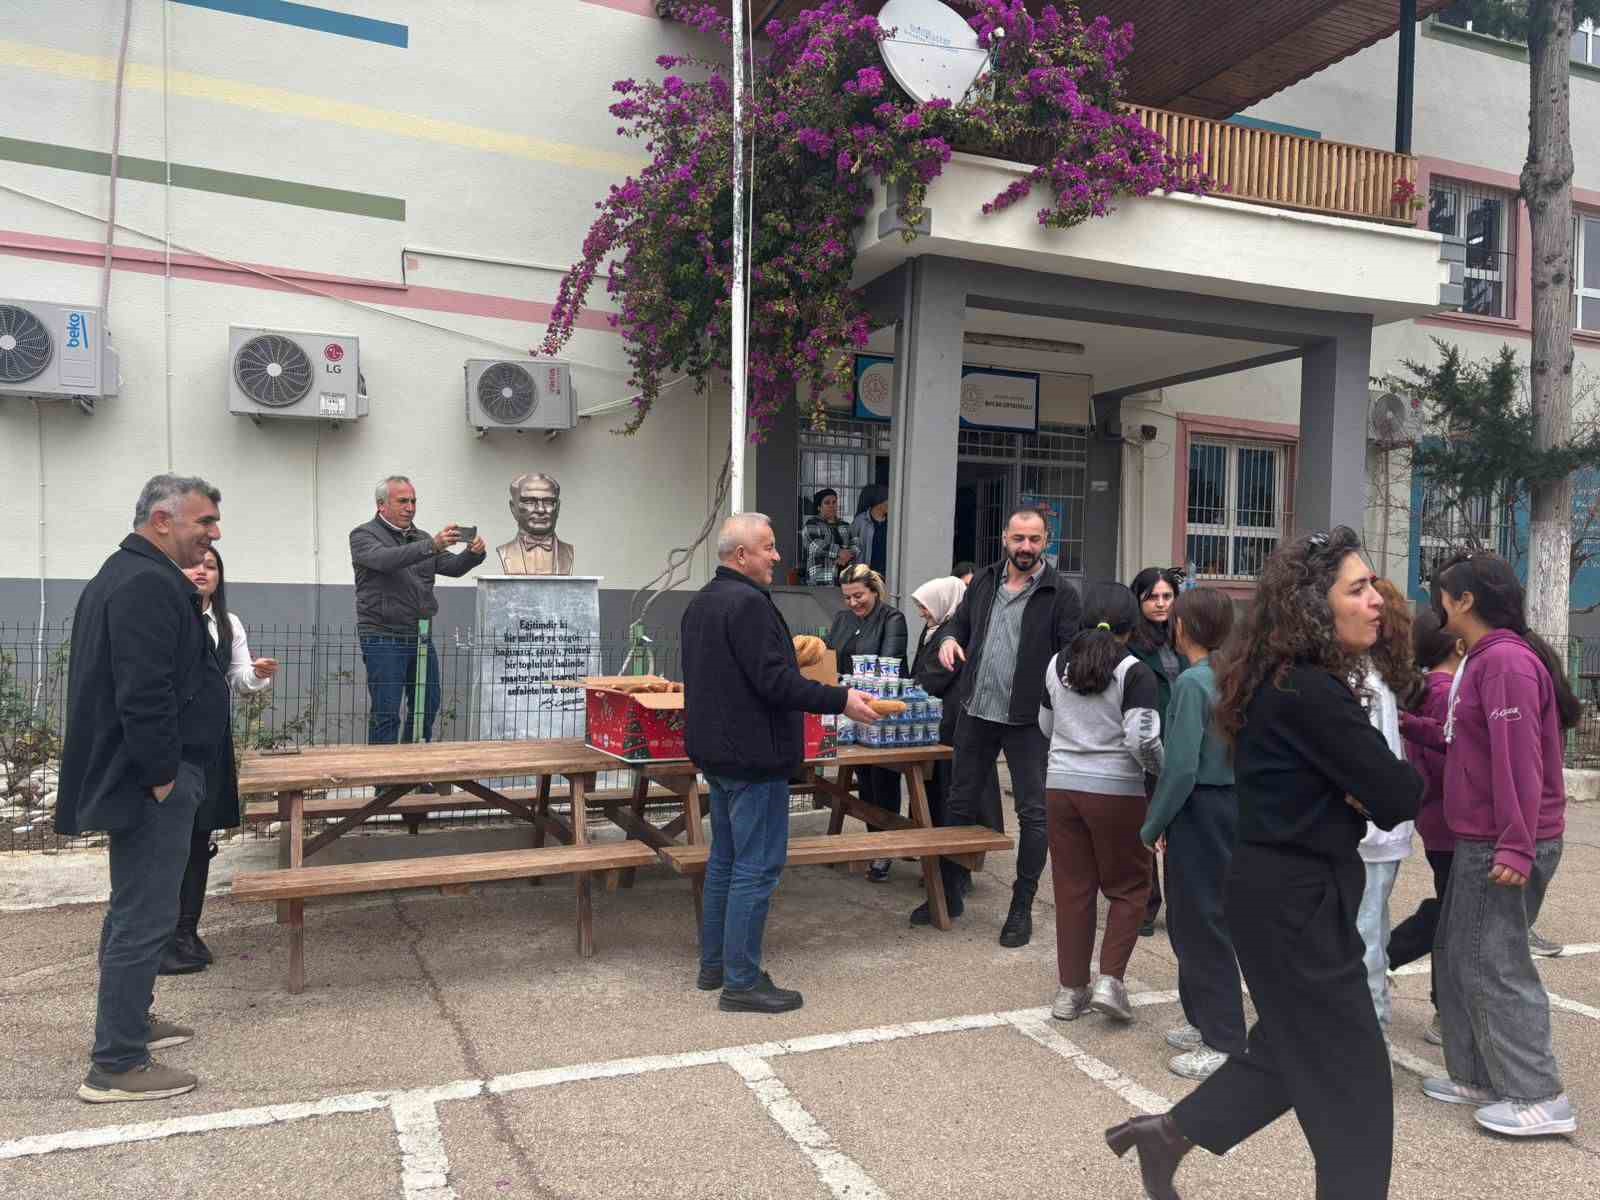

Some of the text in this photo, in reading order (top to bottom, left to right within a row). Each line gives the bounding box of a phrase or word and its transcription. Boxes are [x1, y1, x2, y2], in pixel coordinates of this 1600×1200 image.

[66, 312, 81, 348] beko
[326, 363, 342, 374] LG
[519, 620, 568, 630] Eğitimdir ki
[503, 632, 517, 643] bir
